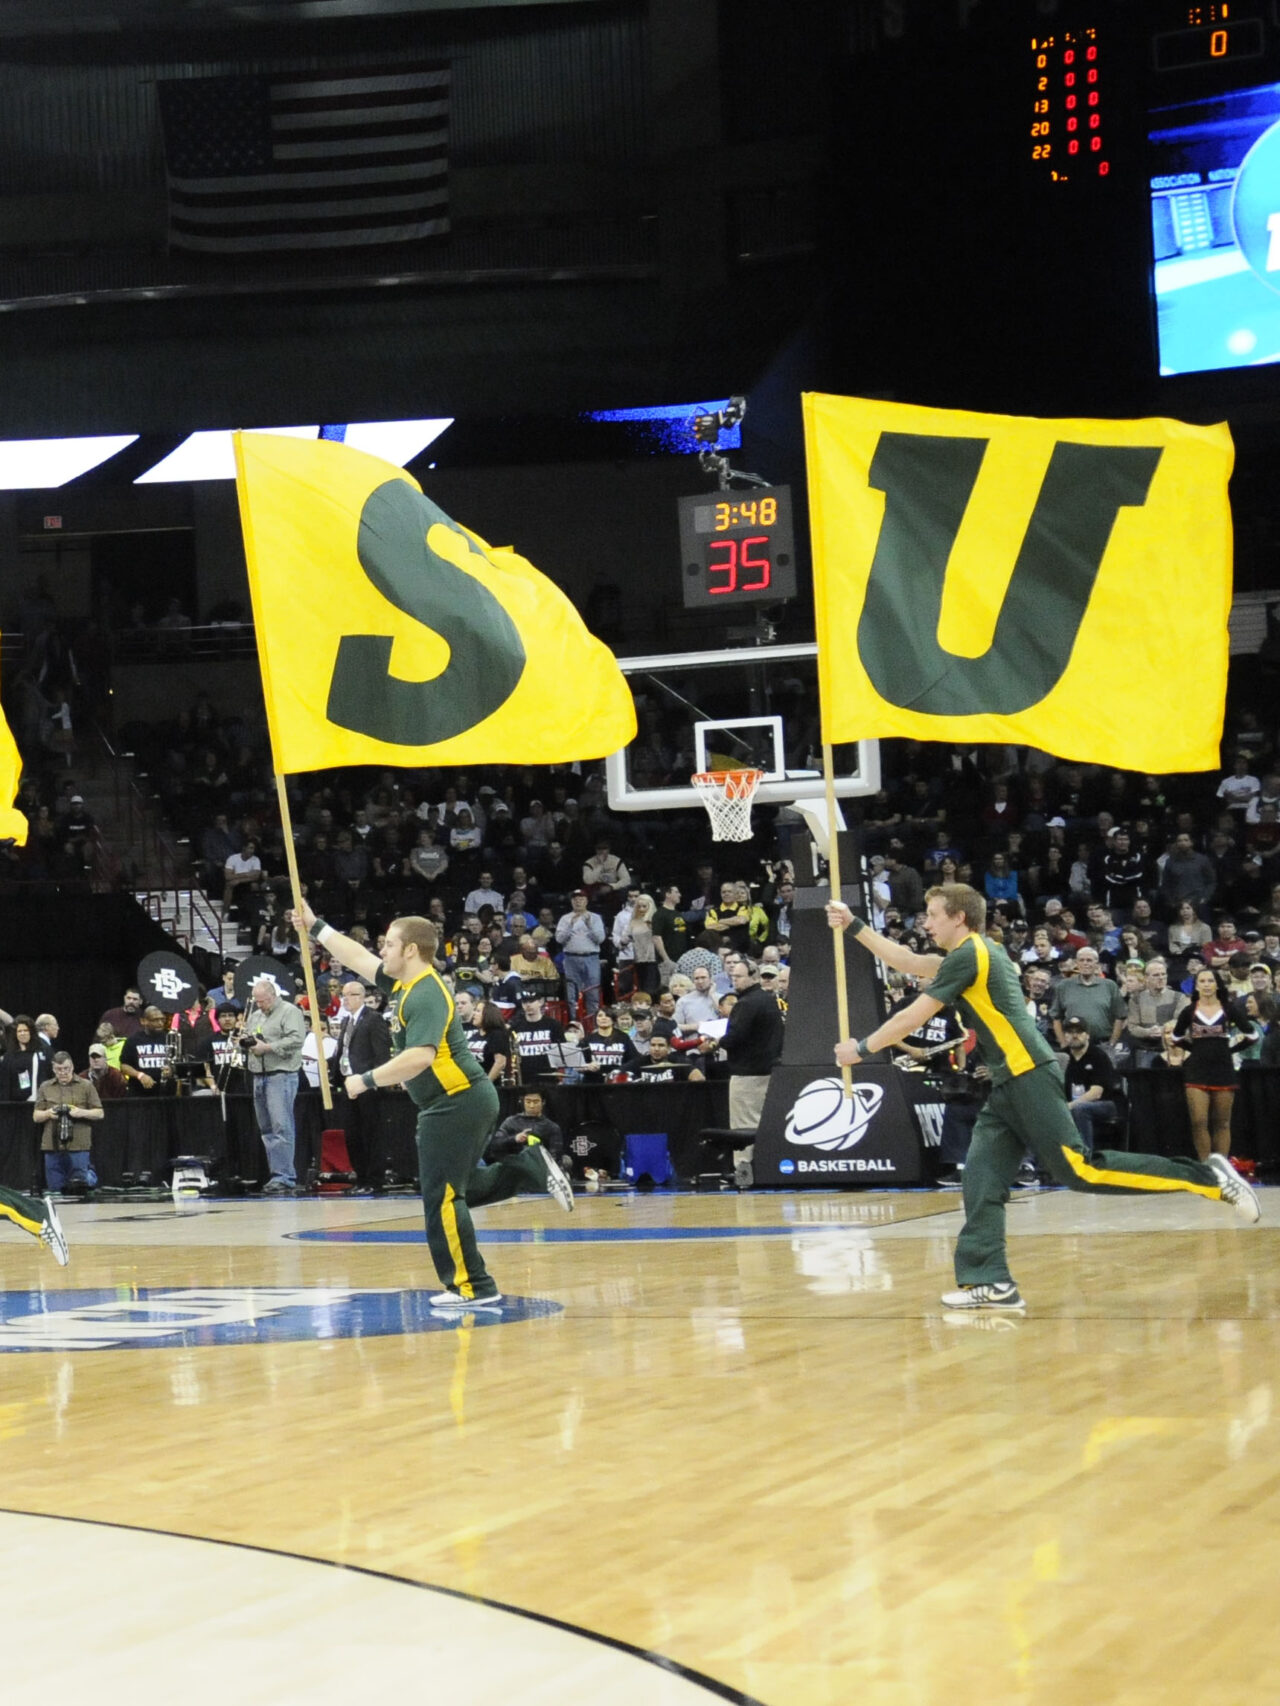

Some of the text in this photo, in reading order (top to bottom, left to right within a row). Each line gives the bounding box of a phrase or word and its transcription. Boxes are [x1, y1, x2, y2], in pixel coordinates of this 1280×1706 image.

[1210, 29, 1228, 57] 0
[1036, 45, 1098, 69] 0 0 0
[1037, 67, 1098, 91] 2 0 0
[1033, 90, 1100, 114] 13 0 0
[1030, 112, 1101, 137] 20 0 0
[1031, 135, 1102, 160] 22 0 0
[1098, 161, 1111, 176] 0
[715, 497, 777, 531] 3:48
[708, 536, 771, 595] 35
[857, 431, 1166, 717] U
[326, 478, 526, 747] S
[518, 1030, 551, 1041] WE ARE
[589, 1043, 605, 1052] WE
[136, 1045, 151, 1055] WE
[798, 1159, 896, 1172] BASKETBALL
